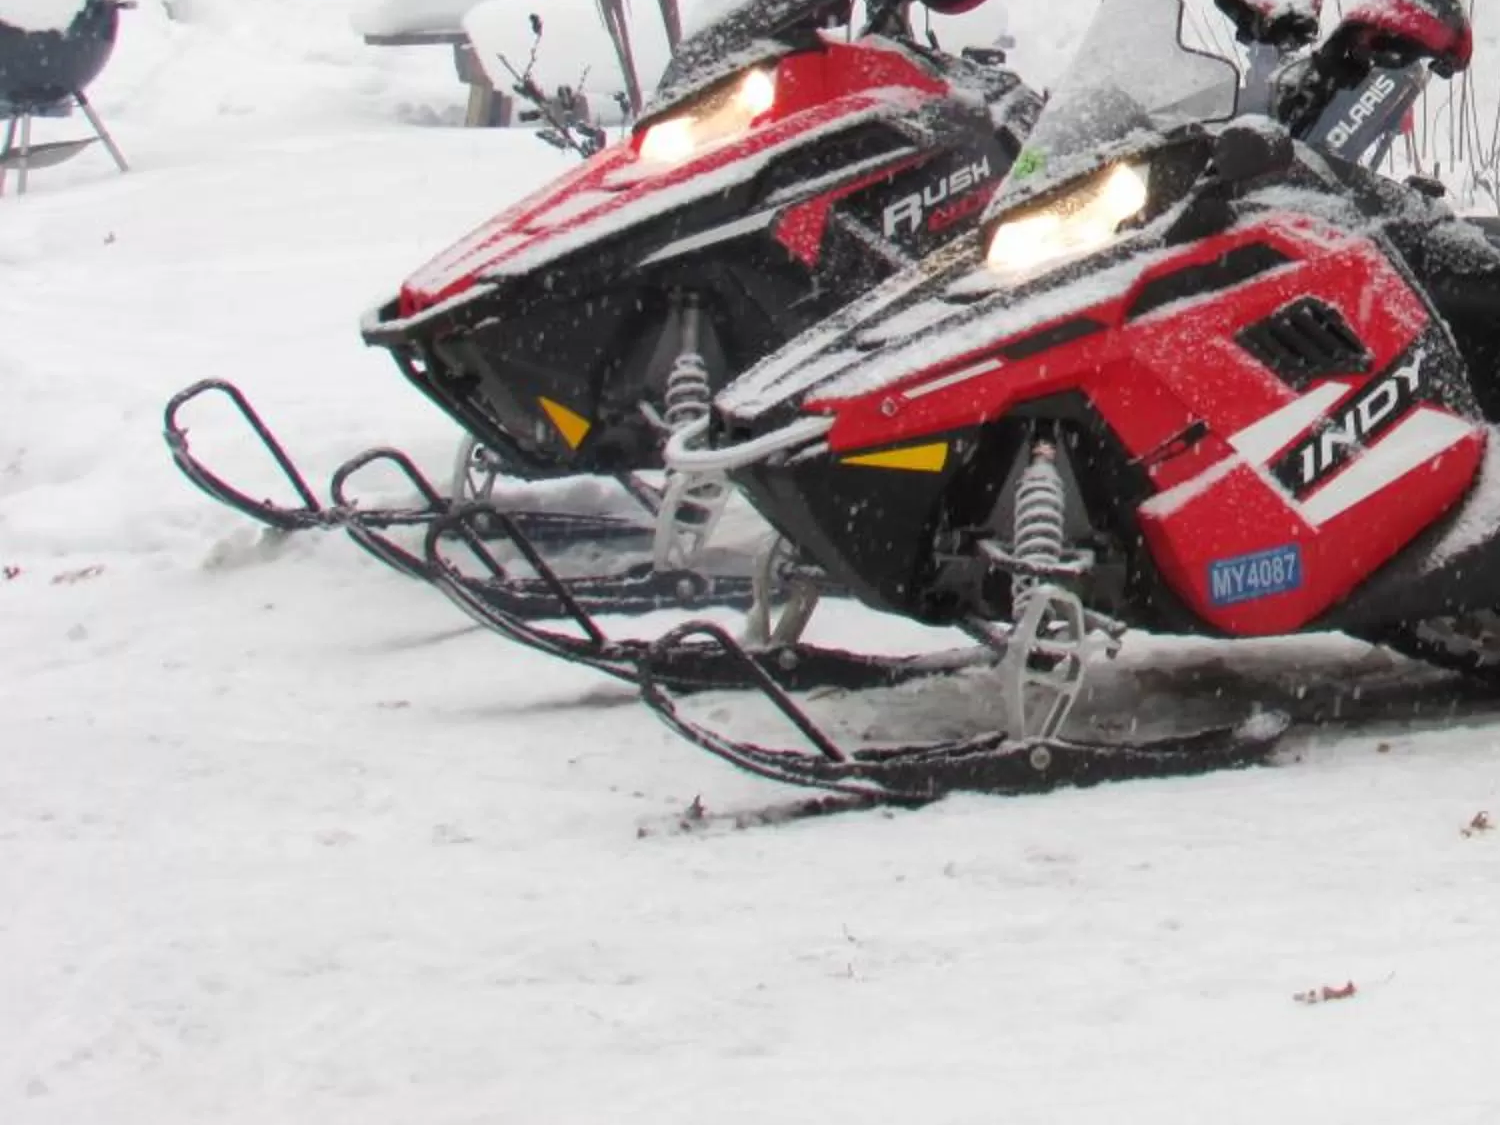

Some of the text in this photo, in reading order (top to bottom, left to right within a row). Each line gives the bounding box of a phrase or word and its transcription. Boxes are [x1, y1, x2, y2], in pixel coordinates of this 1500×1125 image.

[1325, 74, 1396, 156] OLARIS
[883, 155, 990, 237] RUSH
[1301, 348, 1427, 485] INDY
[1211, 551, 1297, 600] MY4087
